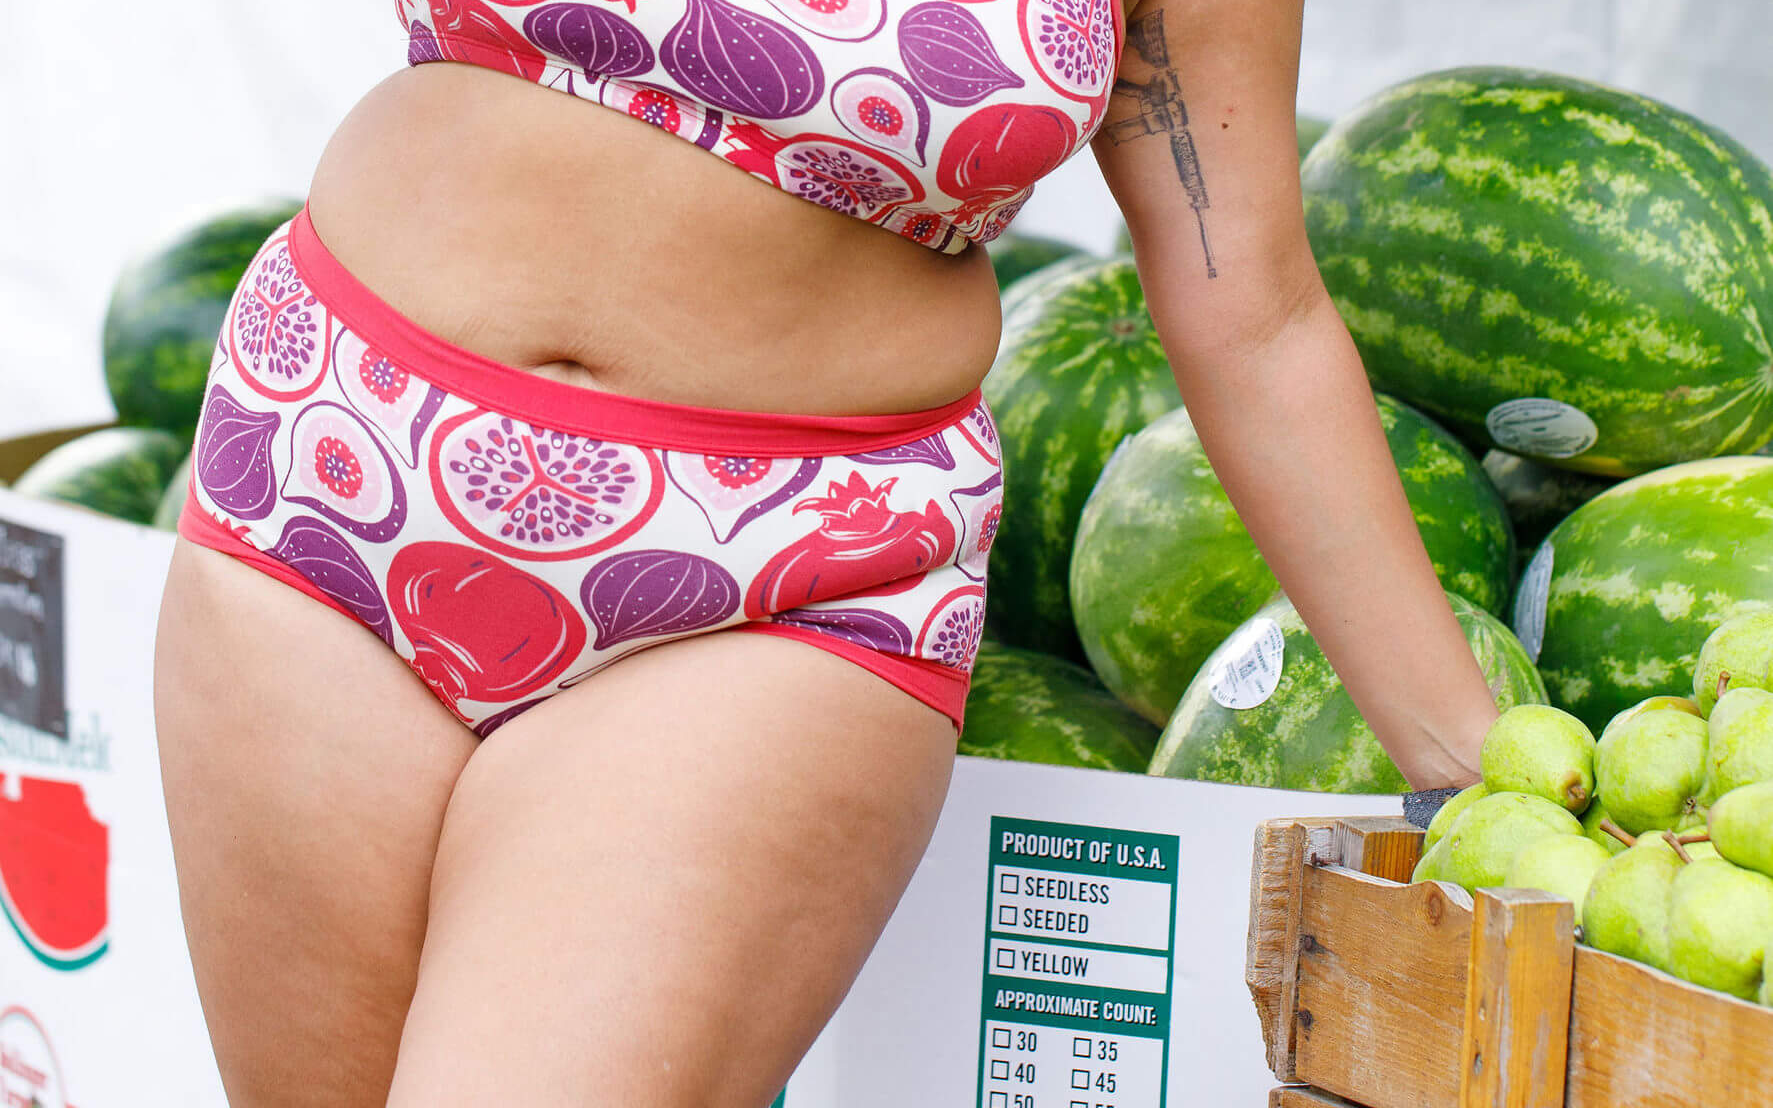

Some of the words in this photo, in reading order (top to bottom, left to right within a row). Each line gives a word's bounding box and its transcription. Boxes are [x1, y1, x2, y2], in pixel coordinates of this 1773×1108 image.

[1001, 831, 1085, 860] PRODUCT
[1089, 840, 1112, 864] OF
[1116, 843, 1166, 870] U.S.A.
[1024, 876, 1109, 904] SEEDLESS
[1023, 908, 1089, 934] SEEDED
[1021, 950, 1089, 977] YELLOW
[995, 989, 1099, 1018] APPROXIMATE
[1102, 1001, 1157, 1025] COUNT:
[1016, 1031, 1037, 1052] 30
[1097, 1040, 1118, 1061] 35
[1014, 1062, 1035, 1083] 40
[1095, 1072, 1116, 1093] 45
